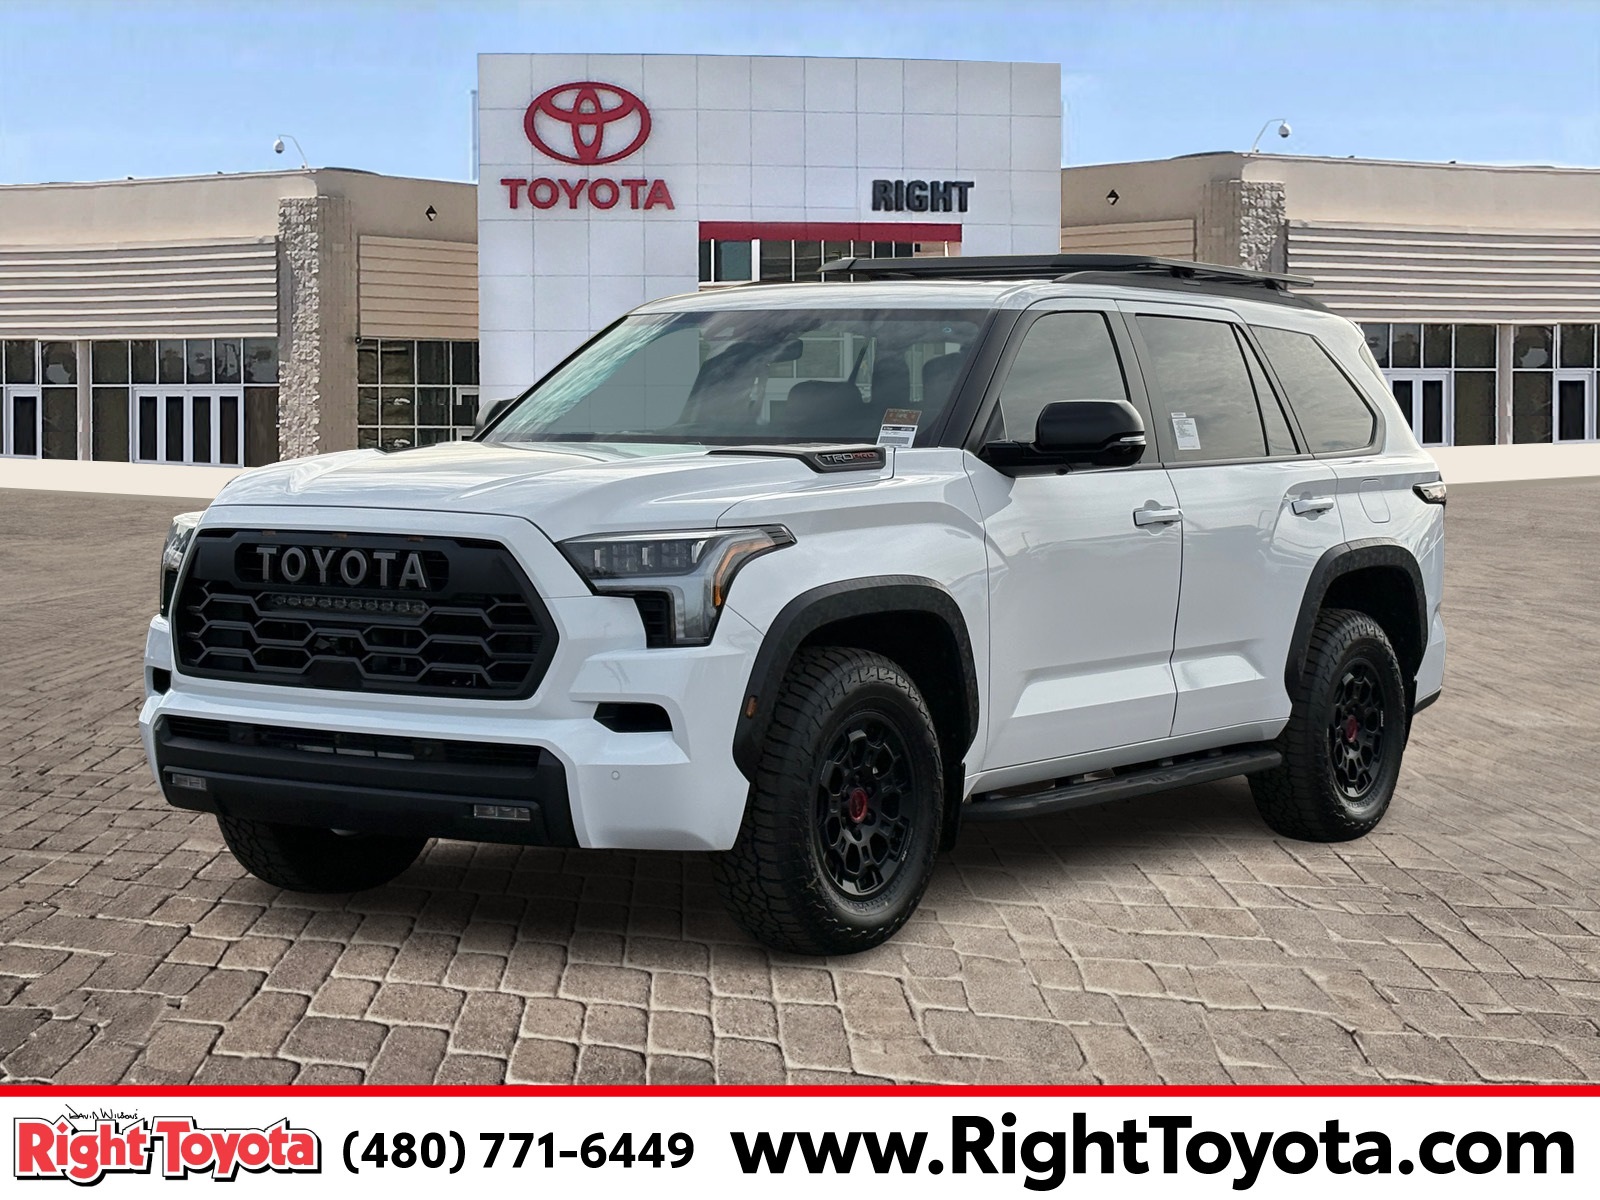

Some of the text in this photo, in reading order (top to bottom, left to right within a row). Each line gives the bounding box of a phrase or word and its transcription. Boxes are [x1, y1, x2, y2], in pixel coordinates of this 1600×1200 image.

[500, 178, 675, 210] TOYOTA
[871, 179, 975, 213] RIGHT
[256, 546, 428, 589] TOYOTA
